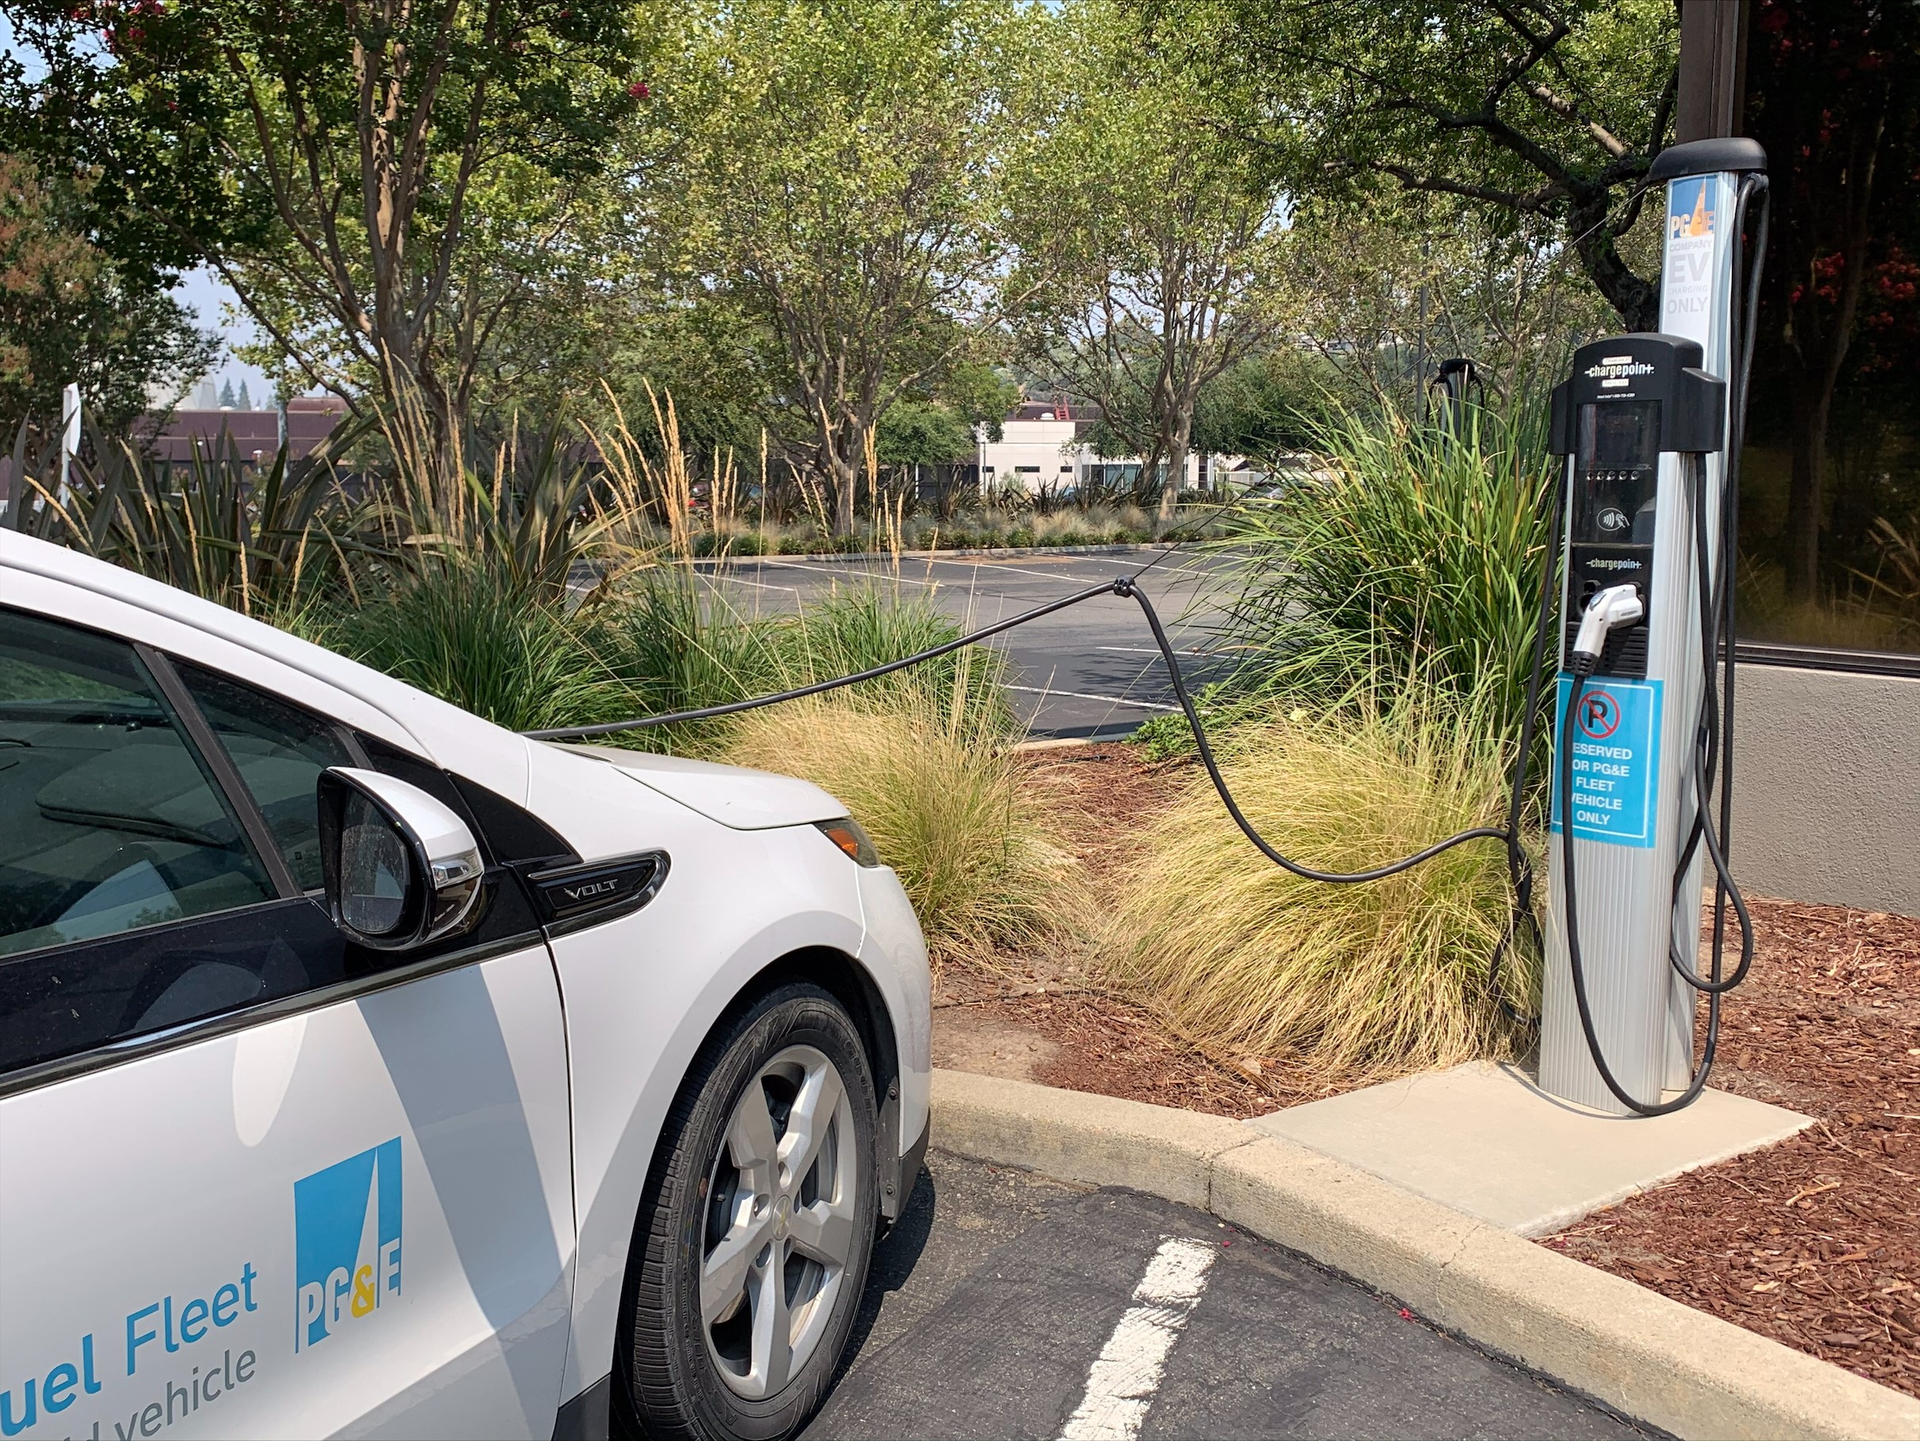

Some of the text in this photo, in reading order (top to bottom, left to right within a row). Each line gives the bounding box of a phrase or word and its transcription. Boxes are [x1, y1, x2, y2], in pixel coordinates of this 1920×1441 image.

[1670, 211, 1714, 240] PG&E
[1669, 239, 1713, 253] COMPANY
[1668, 252, 1711, 284] EV
[1668, 284, 1708, 296] CHARGING
[1666, 296, 1708, 315] ONLY
[1573, 742, 1633, 760] ESERVED
[1573, 759, 1630, 777] OR PG&E
[1576, 776, 1615, 792] FLEET
[1577, 810, 1610, 825] ONLY
[564, 879, 618, 900] VOLT
[296, 1237, 402, 1353] PG&E
[0, 1262, 258, 1437] uel Fleet
[114, 1349, 256, 1441] vehicle
